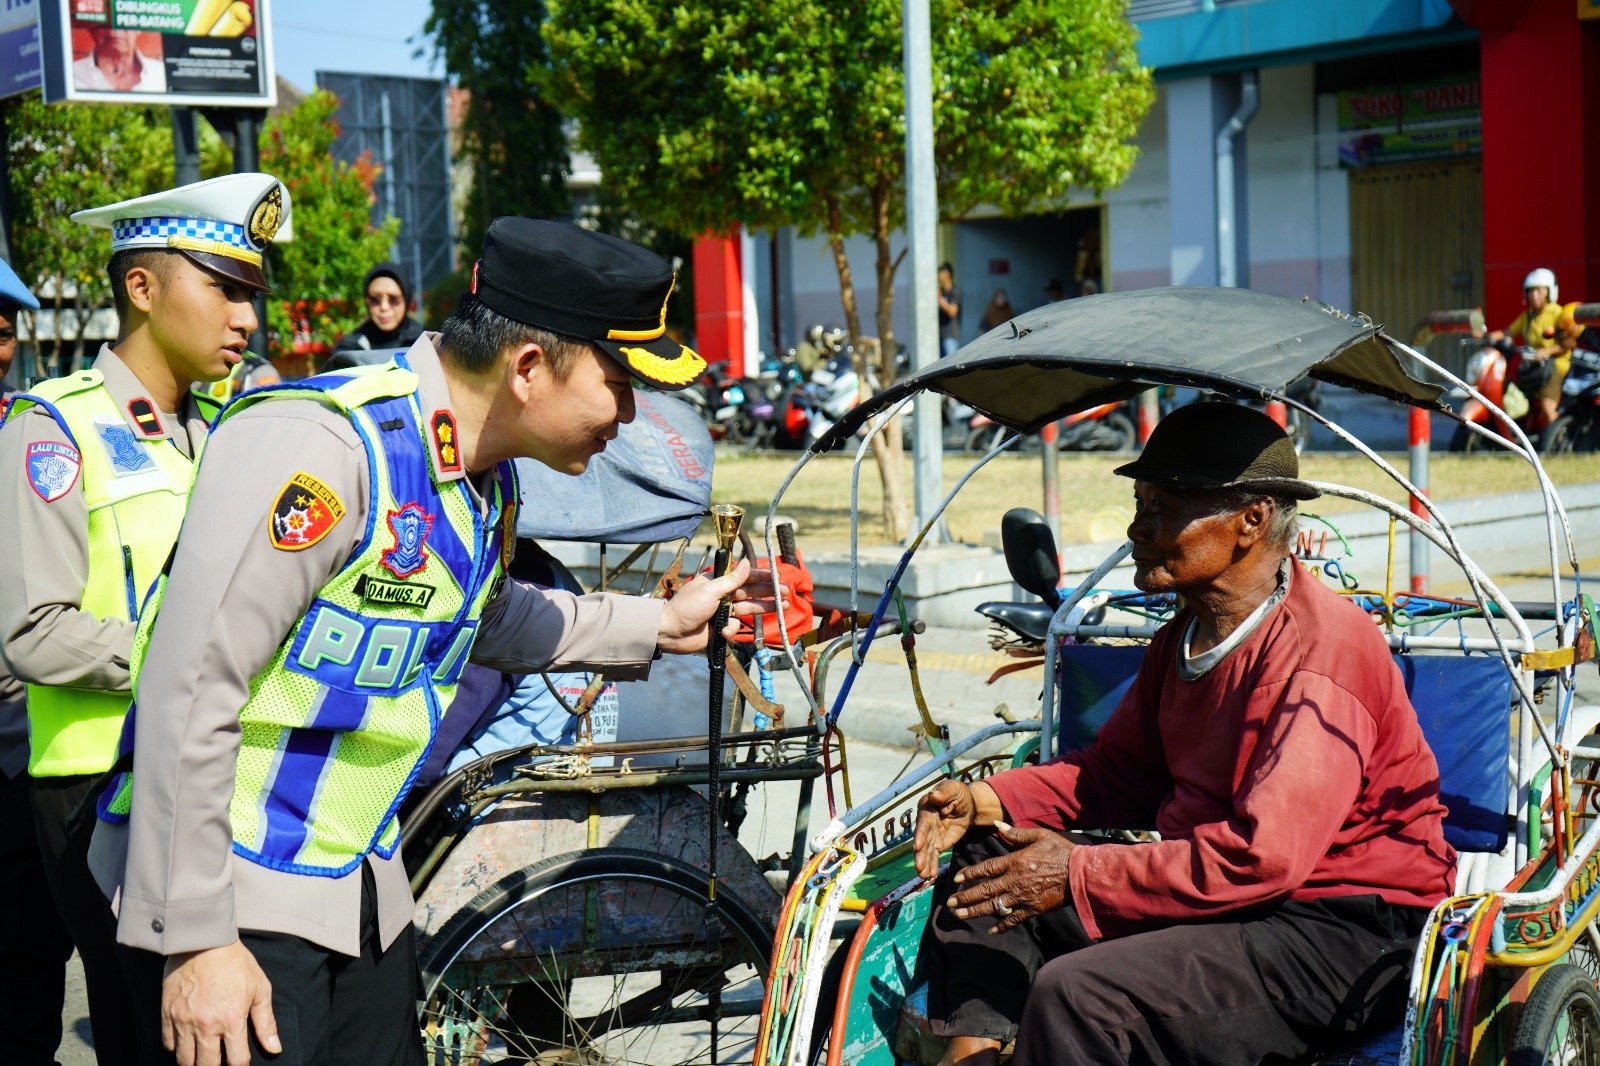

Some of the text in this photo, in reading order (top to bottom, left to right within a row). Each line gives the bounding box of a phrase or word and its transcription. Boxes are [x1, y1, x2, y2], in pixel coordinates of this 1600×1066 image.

[115, 0, 182, 15] DIBUNGKUS
[116, 13, 185, 29] PER-BATANG
[1348, 81, 1480, 118] TOKO "PANI
[31, 444, 79, 462] LALU LINTAS
[297, 475, 342, 516] RESERSE
[368, 583, 427, 603] DAMUS. A
